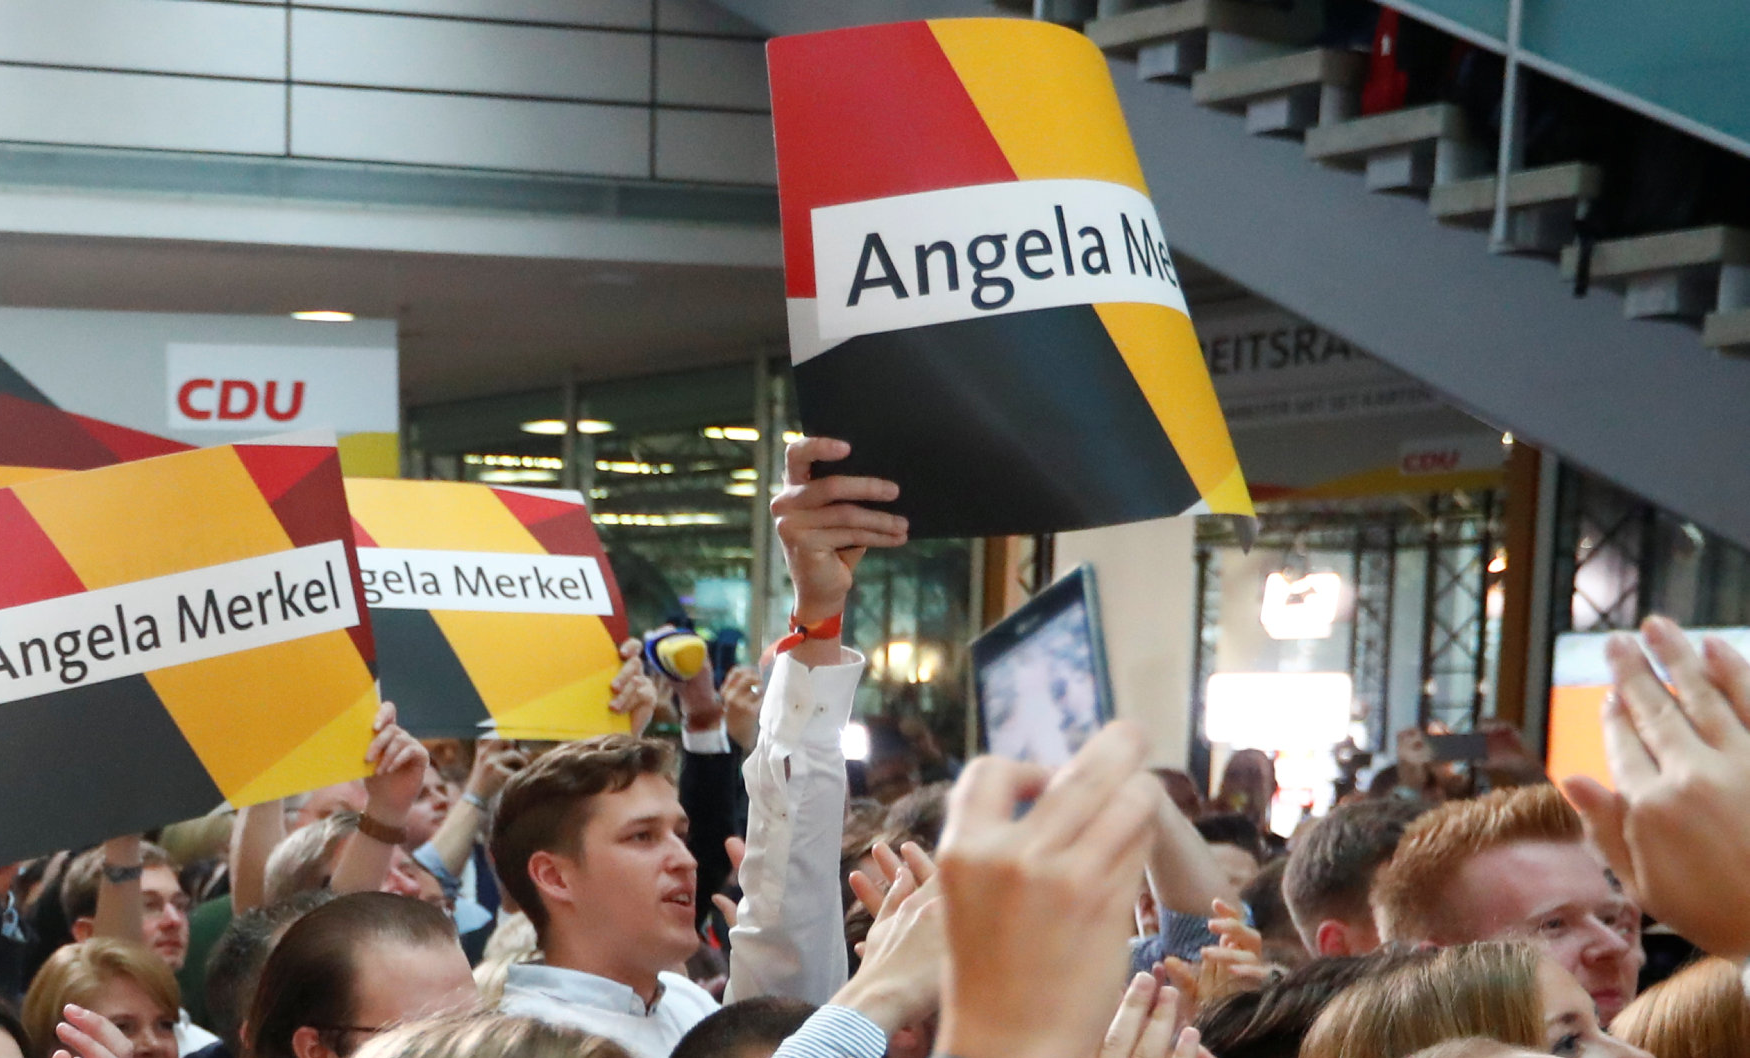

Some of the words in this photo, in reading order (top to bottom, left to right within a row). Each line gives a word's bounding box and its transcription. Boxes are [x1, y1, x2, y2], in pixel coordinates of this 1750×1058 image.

[846, 204, 1111, 310] Angela
[176, 378, 305, 422] CDU
[177, 560, 342, 643] Merkel
[453, 565, 594, 601] Merkel
